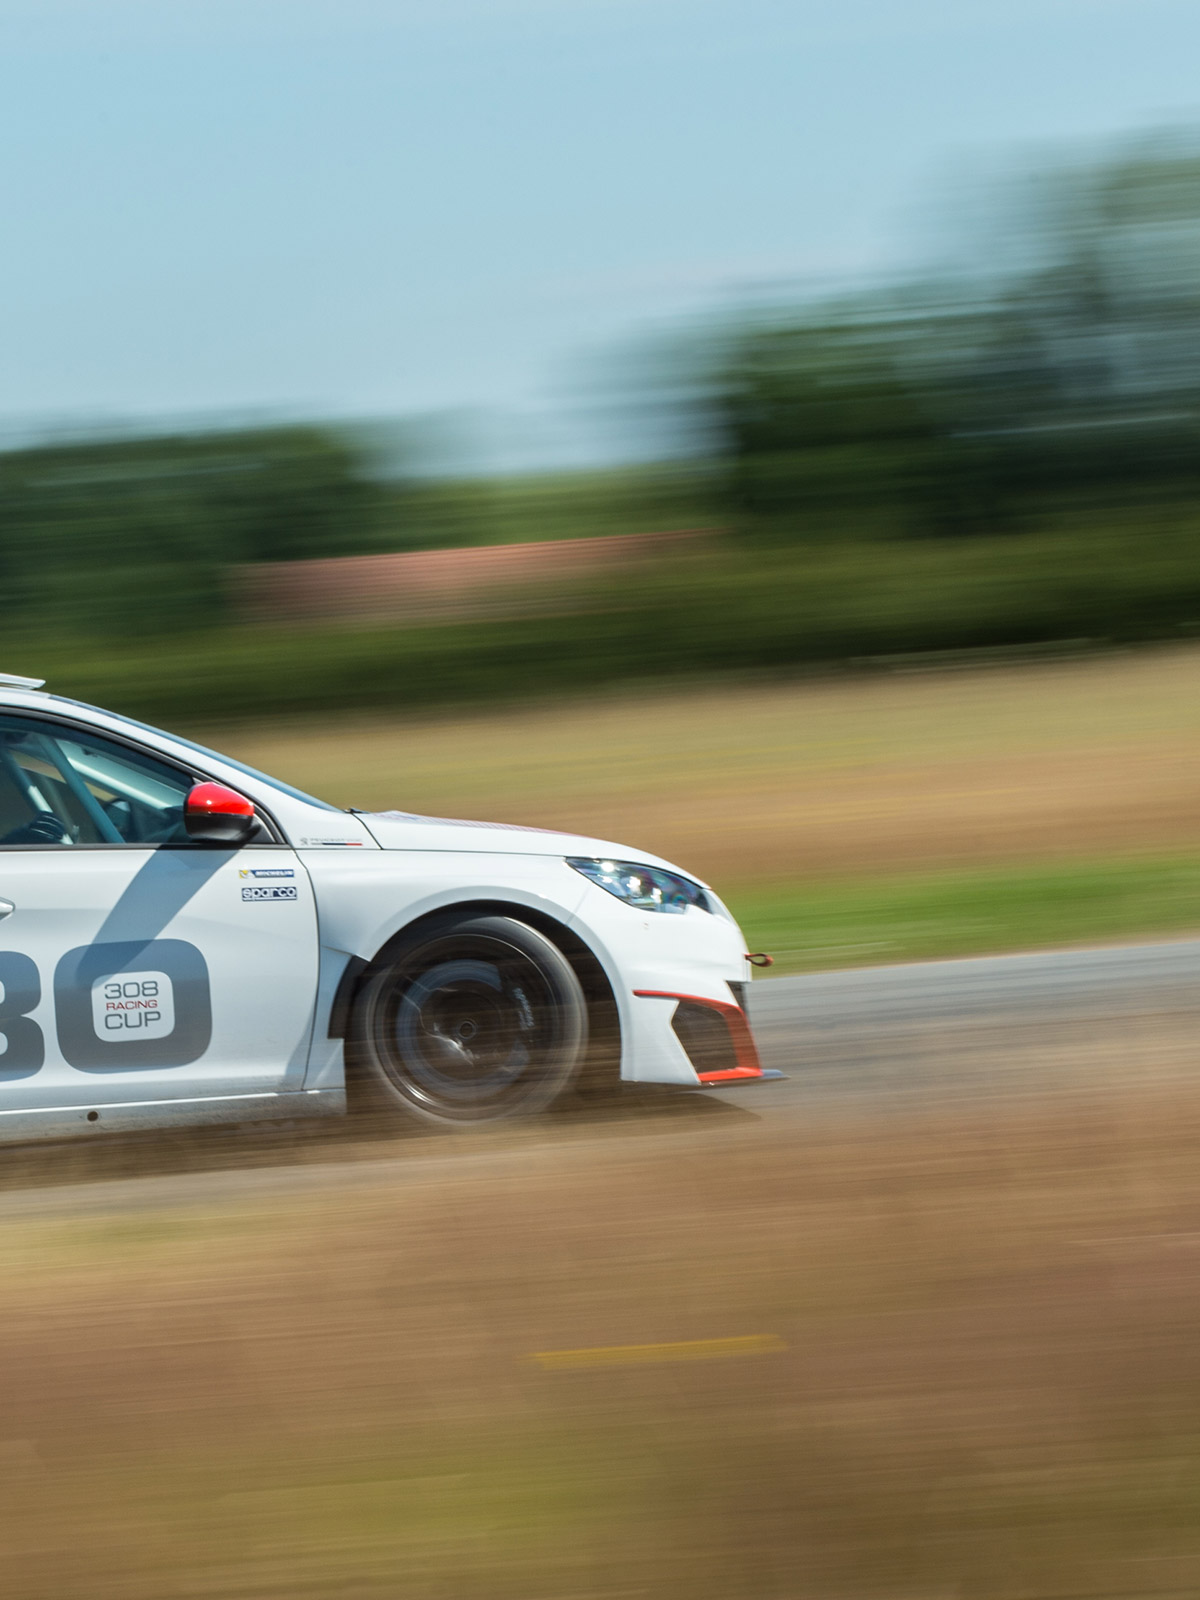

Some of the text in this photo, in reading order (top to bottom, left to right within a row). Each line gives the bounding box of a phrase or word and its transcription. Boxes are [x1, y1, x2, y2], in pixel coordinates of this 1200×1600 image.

[242, 887, 297, 901] sparco
[104, 981, 159, 999] 308
[106, 999, 158, 1011] RACING
[104, 1011, 161, 1030] CUP
